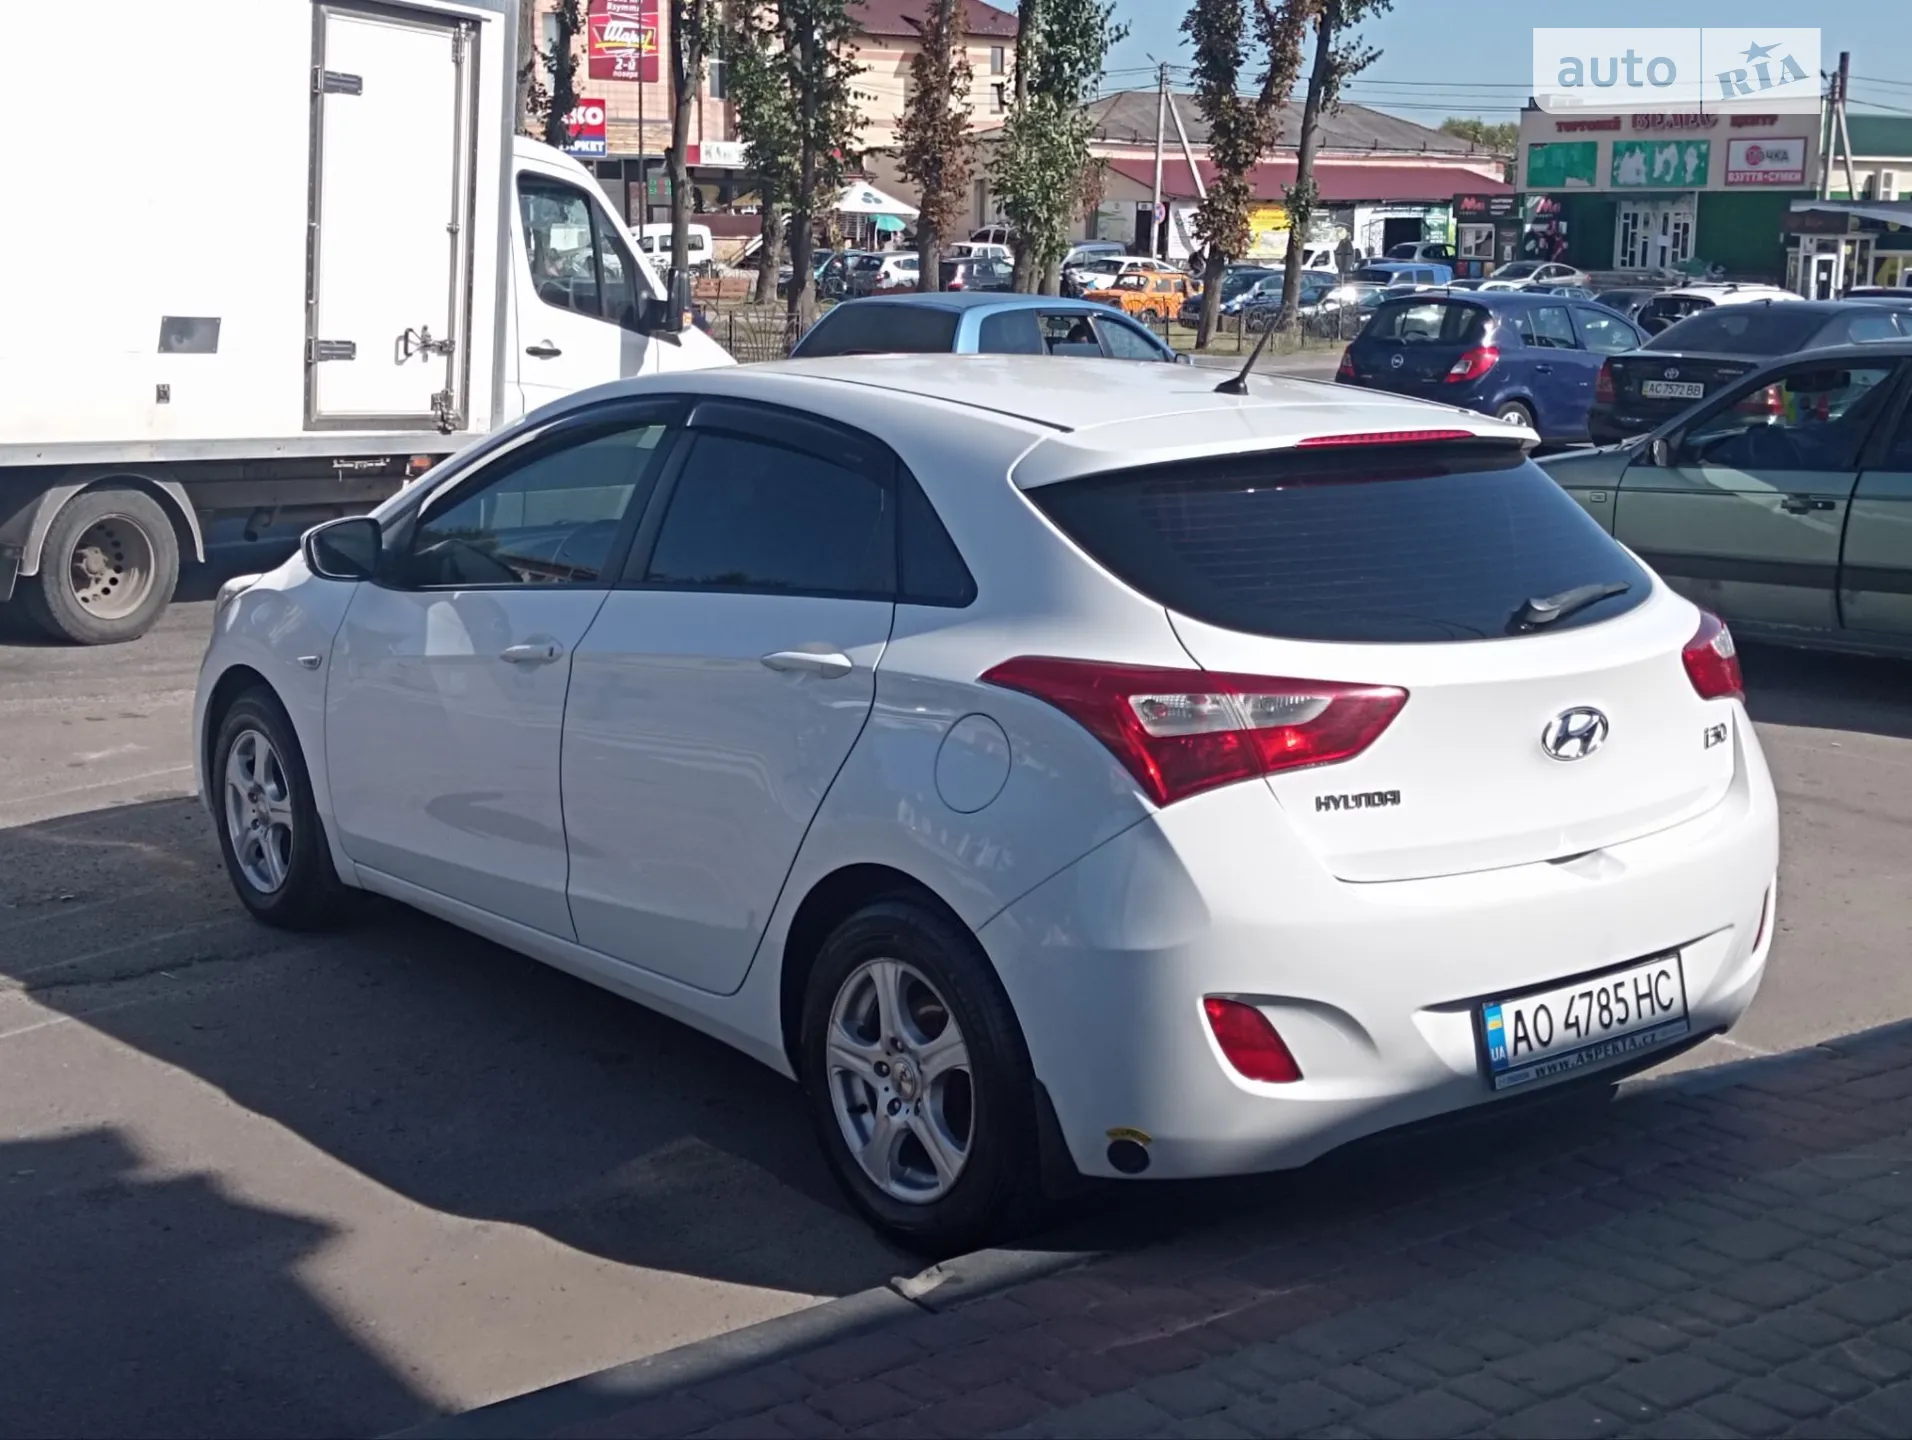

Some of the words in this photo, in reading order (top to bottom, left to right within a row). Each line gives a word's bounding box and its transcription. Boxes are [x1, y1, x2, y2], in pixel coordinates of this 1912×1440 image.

[1315, 790, 1401, 812] HYUNDAI
[1512, 1003, 1554, 1057] AO
[1563, 981, 1630, 1039] 4785
[1633, 969, 1674, 1020] HC
[1490, 1046, 1506, 1061] UA
